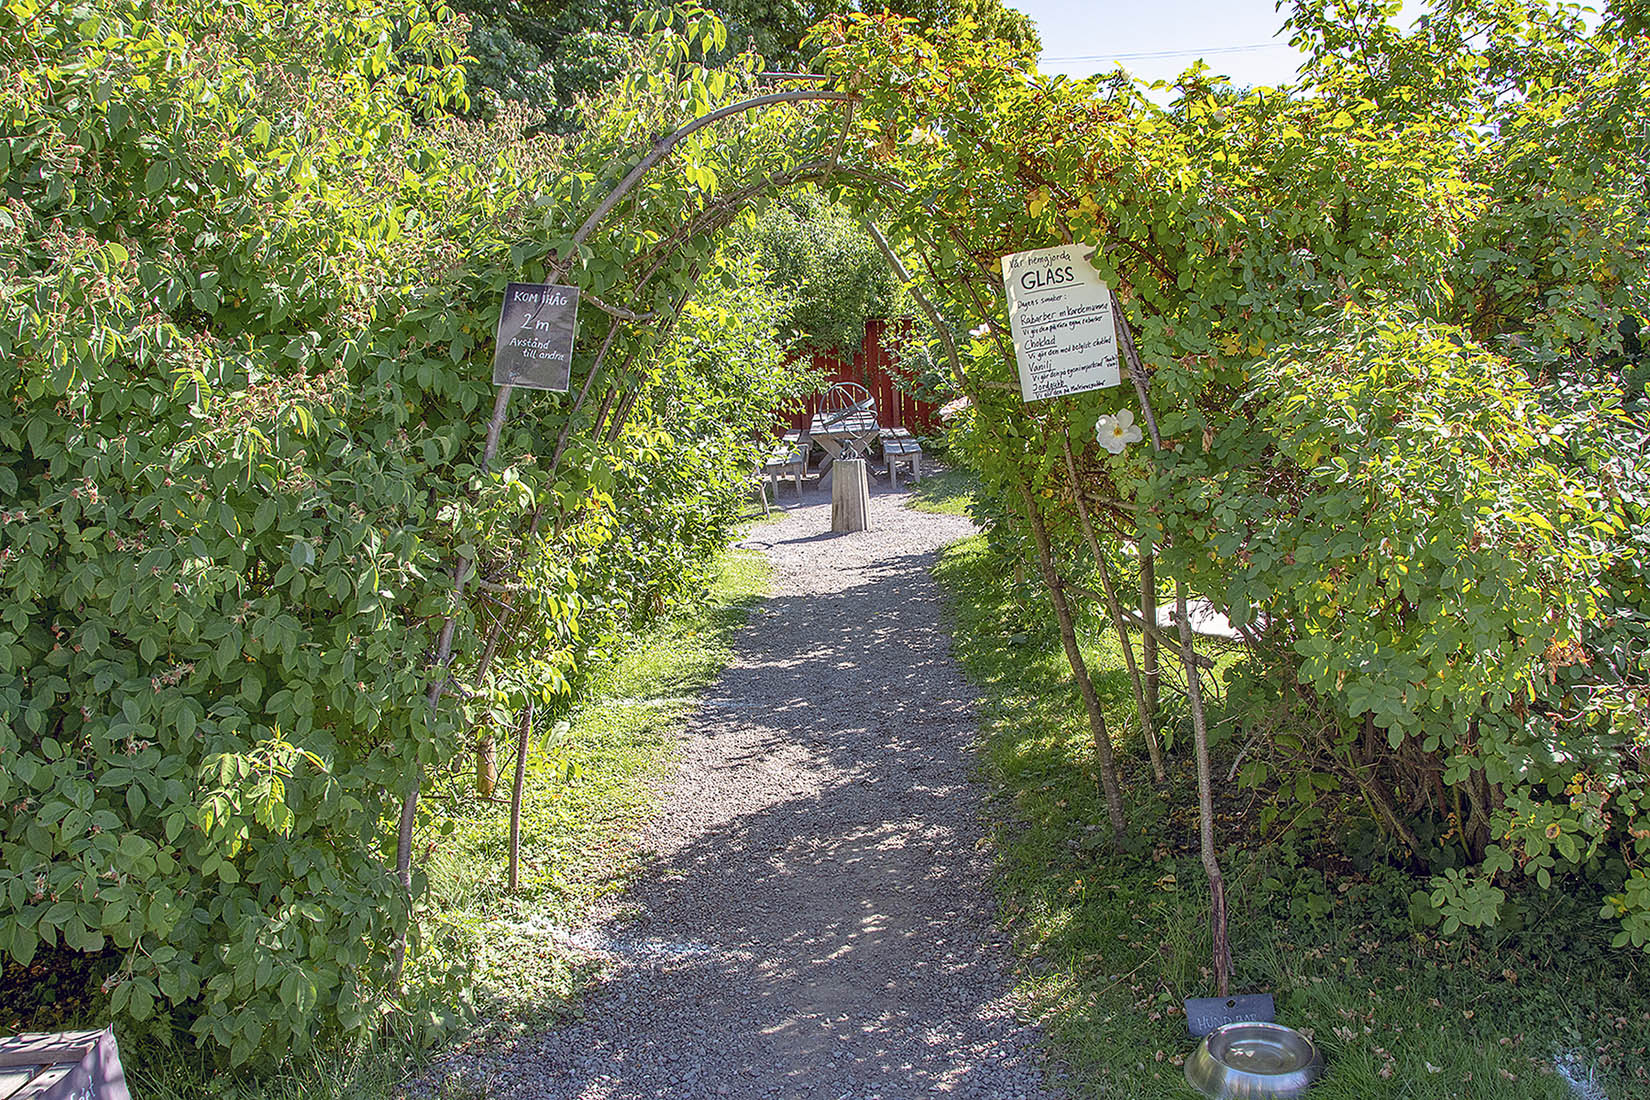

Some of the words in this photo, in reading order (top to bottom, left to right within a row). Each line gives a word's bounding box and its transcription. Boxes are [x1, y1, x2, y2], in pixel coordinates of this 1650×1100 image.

[1028, 250, 1072, 268] hemgjorda
[1020, 266, 1075, 290] GLASS
[513, 291, 538, 304] KOM
[520, 313, 533, 330] 2
[535, 320, 550, 332] m
[1020, 311, 1057, 326] Rabarber
[509, 337, 551, 350] Avstånd
[522, 349, 537, 359] till
[538, 351, 565, 361] andra
